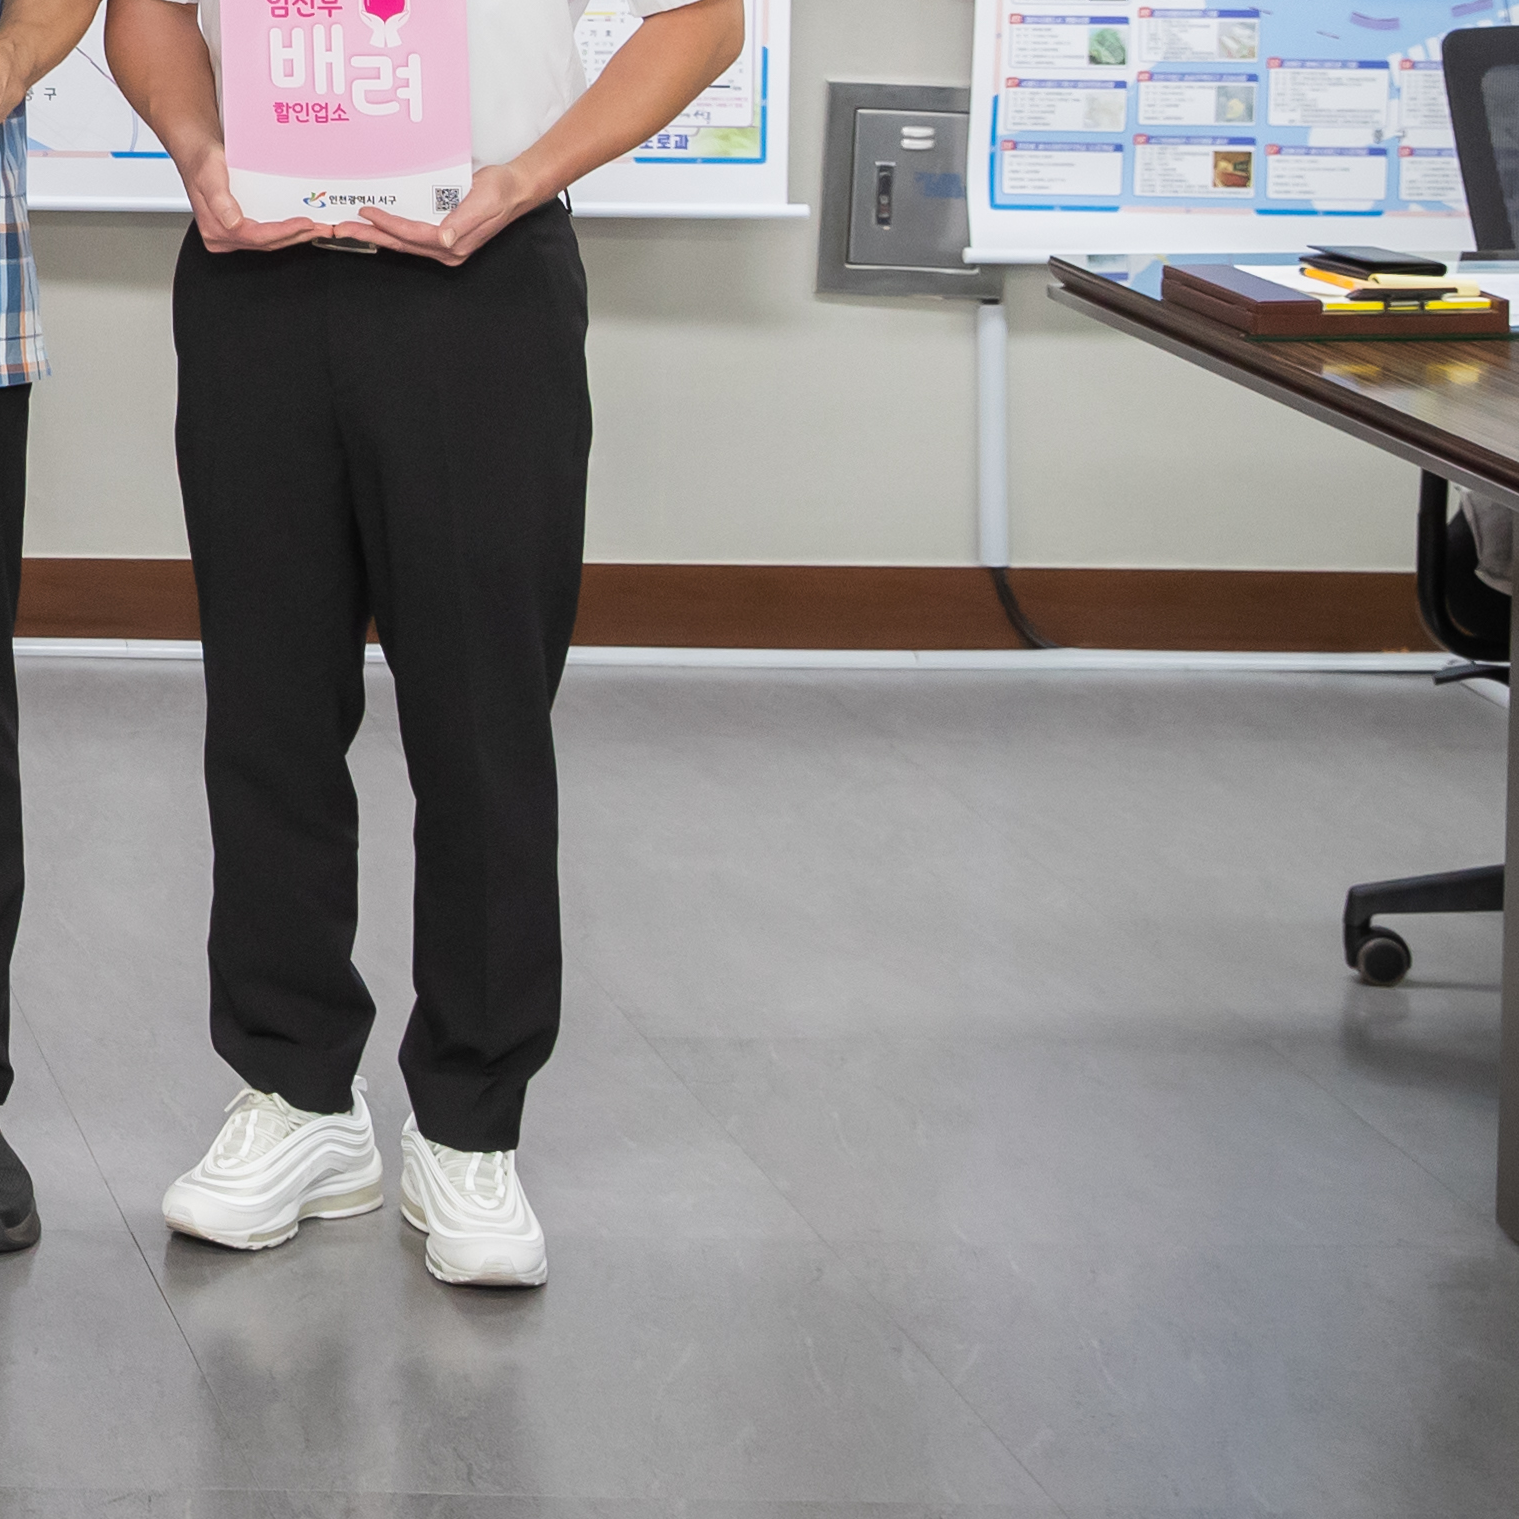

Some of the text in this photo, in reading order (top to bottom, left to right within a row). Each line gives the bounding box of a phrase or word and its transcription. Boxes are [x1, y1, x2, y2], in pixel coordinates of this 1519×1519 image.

[268, 23, 423, 123] 배려
[272, 101, 351, 124] 할인업소
[328, 194, 397, 206] 인천광역시 서구
